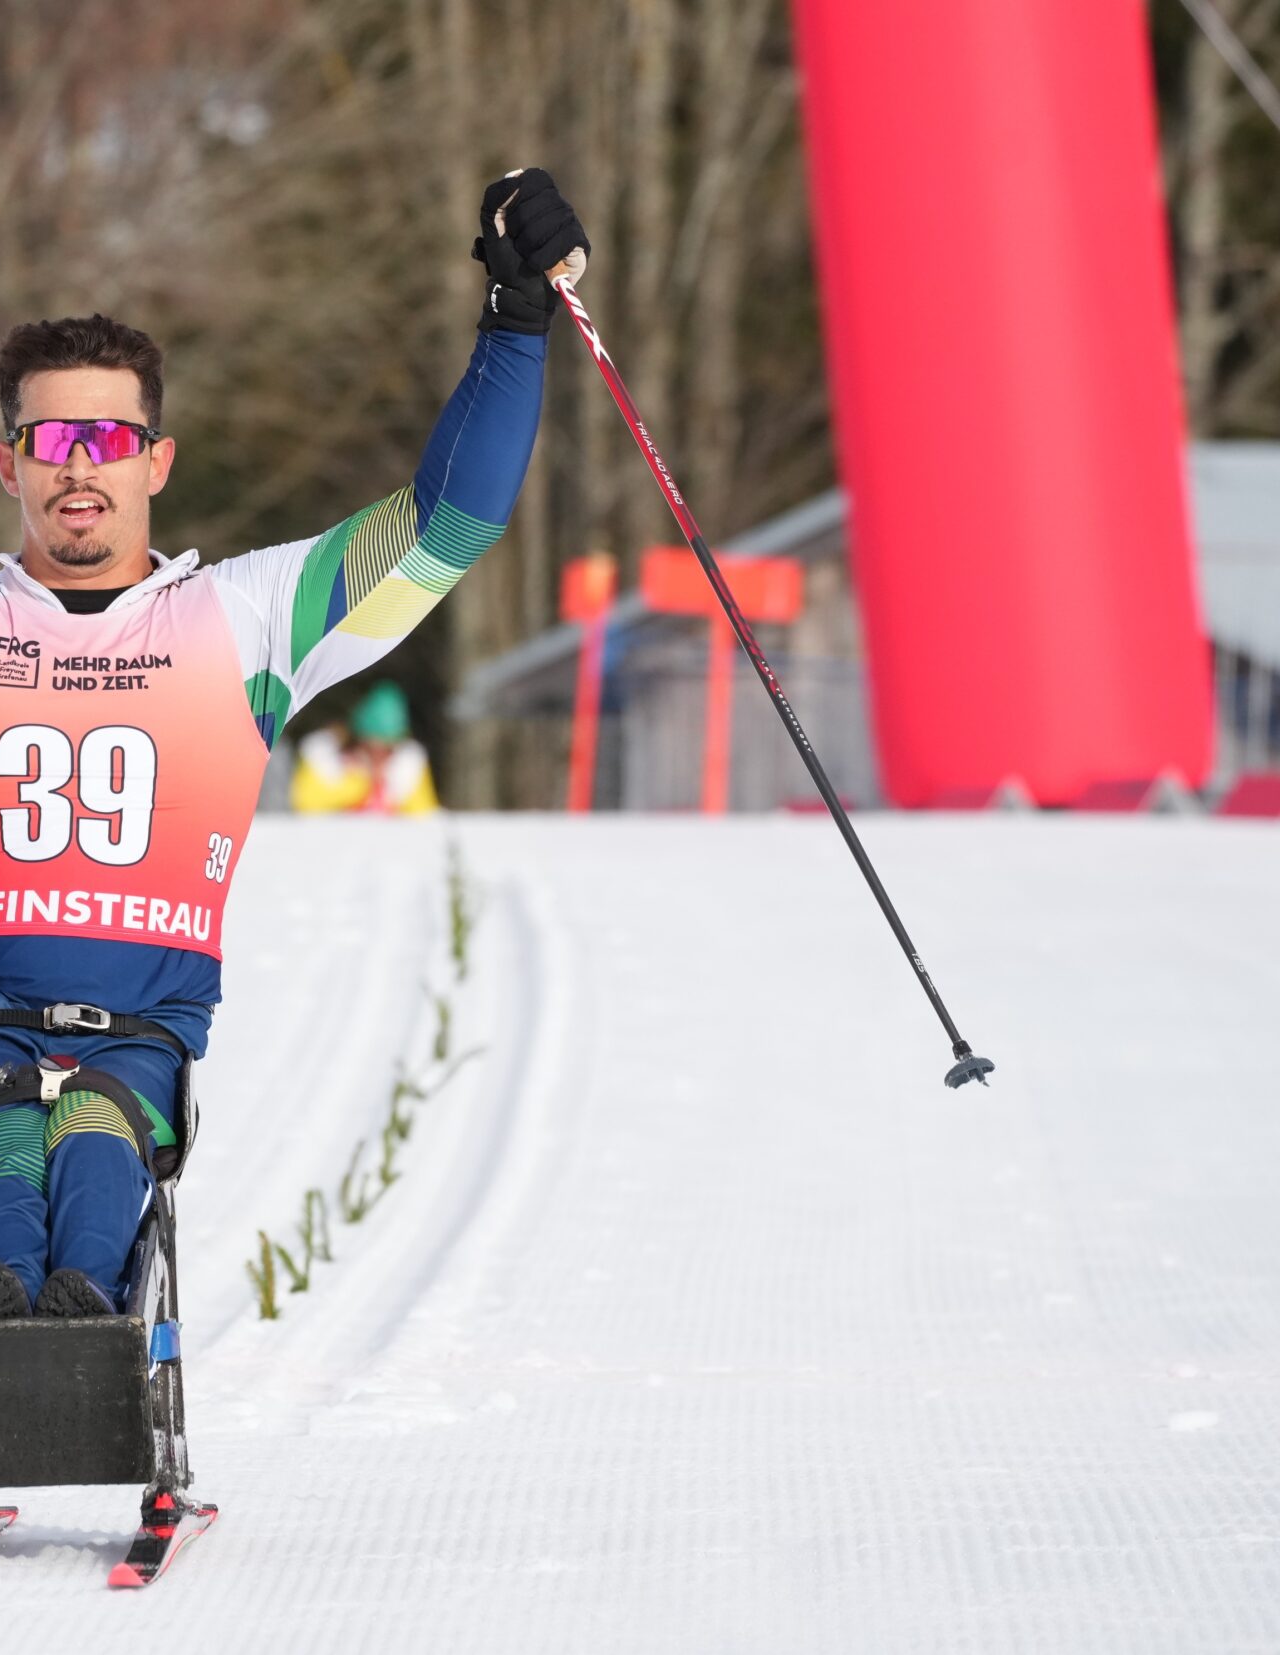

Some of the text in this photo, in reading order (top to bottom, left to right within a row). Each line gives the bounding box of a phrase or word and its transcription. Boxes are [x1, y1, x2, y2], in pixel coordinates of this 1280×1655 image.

[635, 421, 658, 455] TRIAC
[661, 473, 683, 505] AERO
[53, 654, 173, 672] MEHR RAUM
[52, 675, 149, 691] UND ZEIT.
[204, 831, 233, 885] 39
